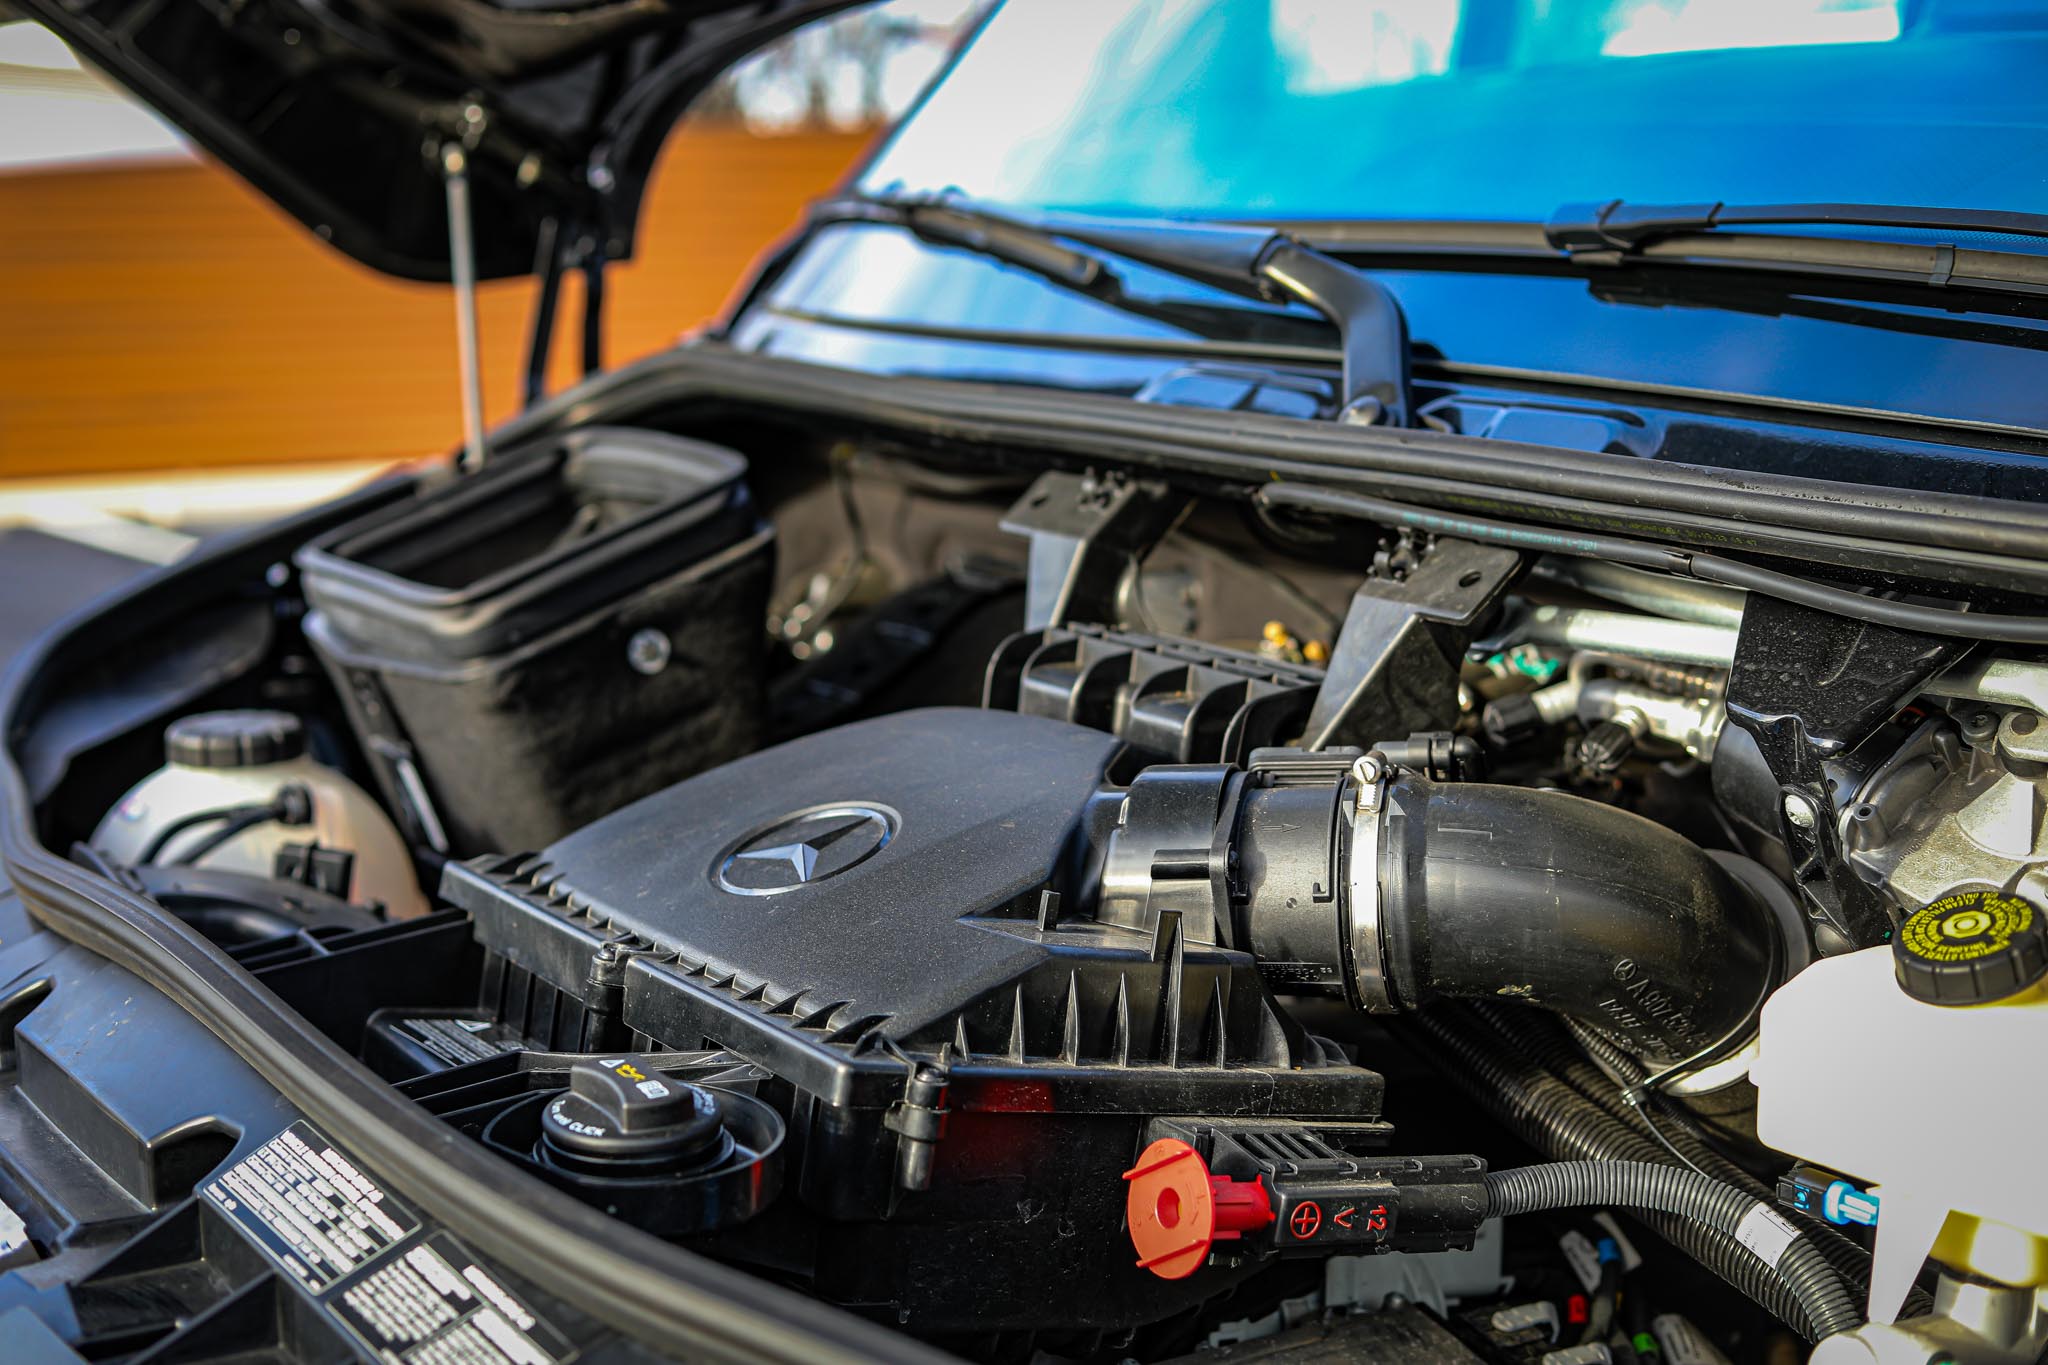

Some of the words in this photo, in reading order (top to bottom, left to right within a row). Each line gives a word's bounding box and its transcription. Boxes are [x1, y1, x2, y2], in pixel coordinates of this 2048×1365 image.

[1944, 898, 1976, 910] CLEAN
[1956, 892, 1980, 902] ONLY
[1336, 1208, 1357, 1229] V
[1367, 1205, 1388, 1231] 12
